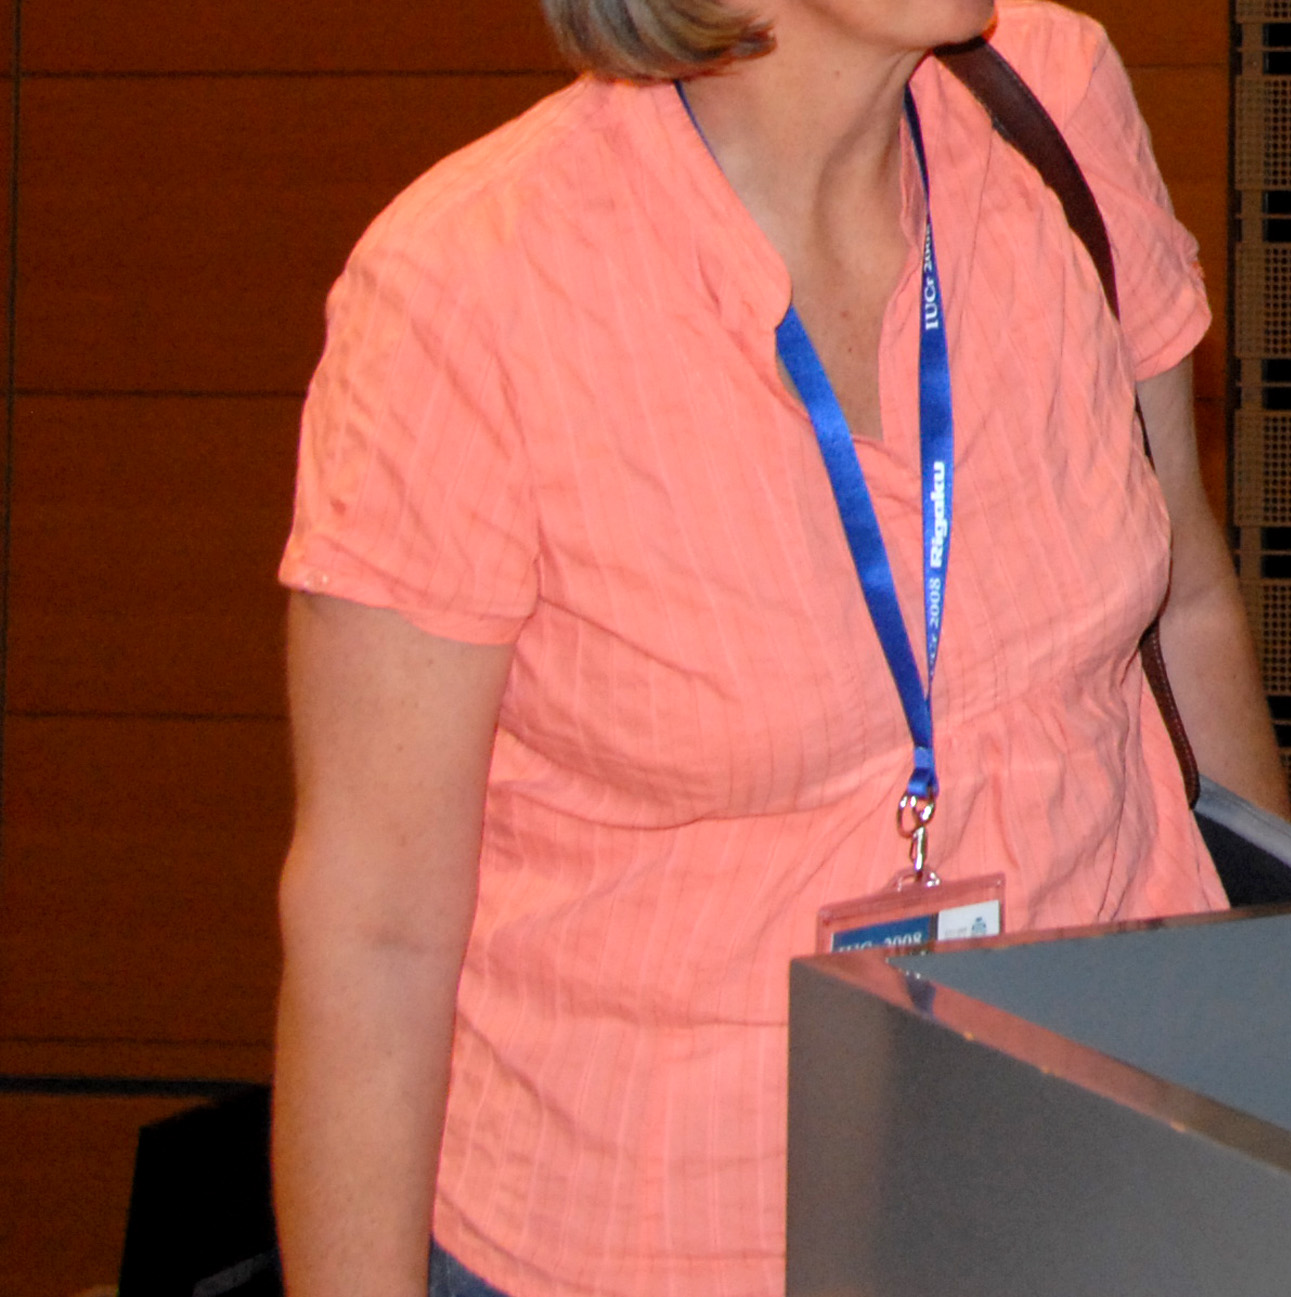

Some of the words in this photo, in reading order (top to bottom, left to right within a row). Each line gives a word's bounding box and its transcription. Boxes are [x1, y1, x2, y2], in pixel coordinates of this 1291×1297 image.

[924, 277, 939, 331] IUCr
[930, 460, 948, 569] Rigaku
[929, 577, 941, 630] 2008
